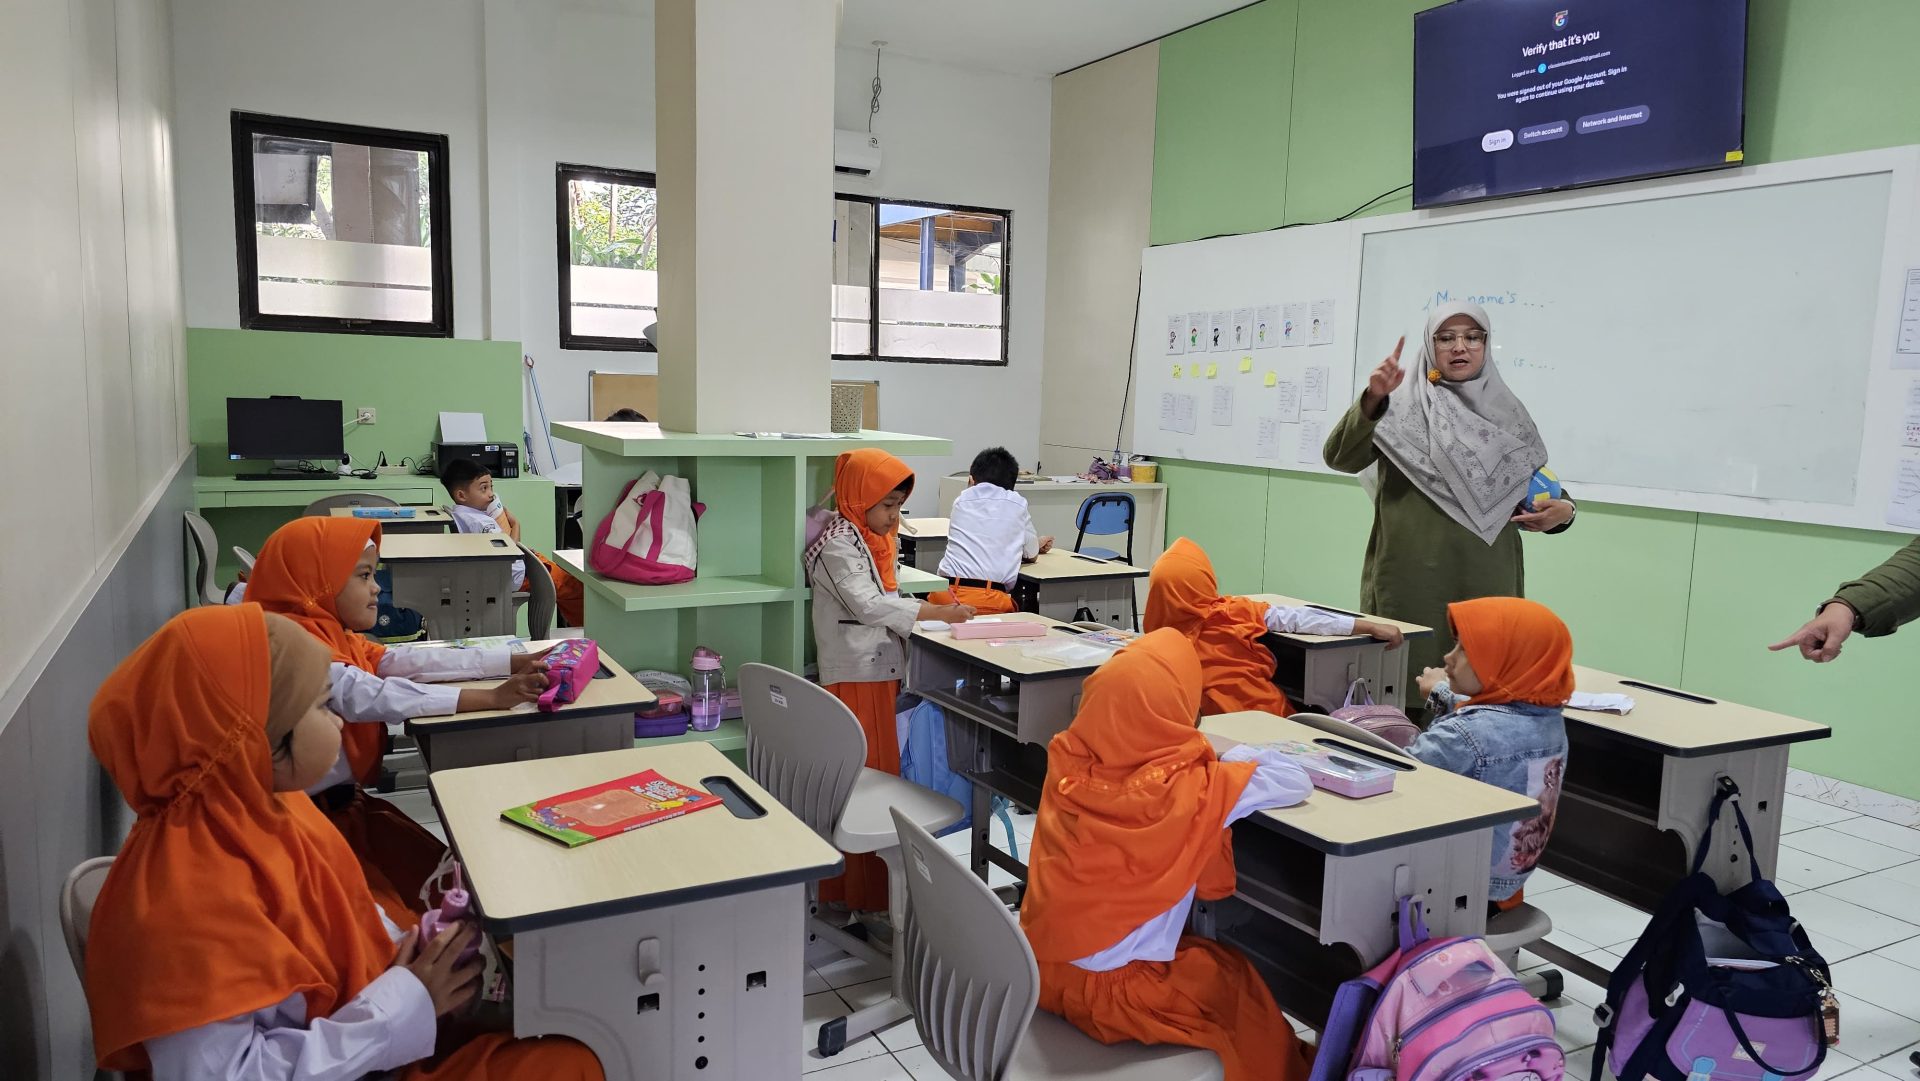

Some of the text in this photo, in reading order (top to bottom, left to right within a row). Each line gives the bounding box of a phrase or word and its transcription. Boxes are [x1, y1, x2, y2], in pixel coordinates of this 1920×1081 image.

[1522, 43, 1548, 57] Verify
[1549, 38, 1567, 51] that
[1582, 30, 1600, 45] you
[1497, 92, 1507, 100] You
[1519, 86, 1536, 95] signed
[1536, 84, 1545, 92] out
[1545, 81, 1552, 90] of
[1551, 80, 1564, 91] your
[1563, 75, 1583, 87] Google
[1583, 71, 1607, 81] Account.
[1607, 67, 1620, 77] Sign
[1620, 65, 1628, 73] in
[1511, 70, 1525, 78] Logged
[1515, 78, 1605, 104] again to continue using your device.
[1582, 111, 1643, 128] Network and Internet
[1523, 126, 1563, 139] Switch account
[1489, 138, 1500, 146] Sign
